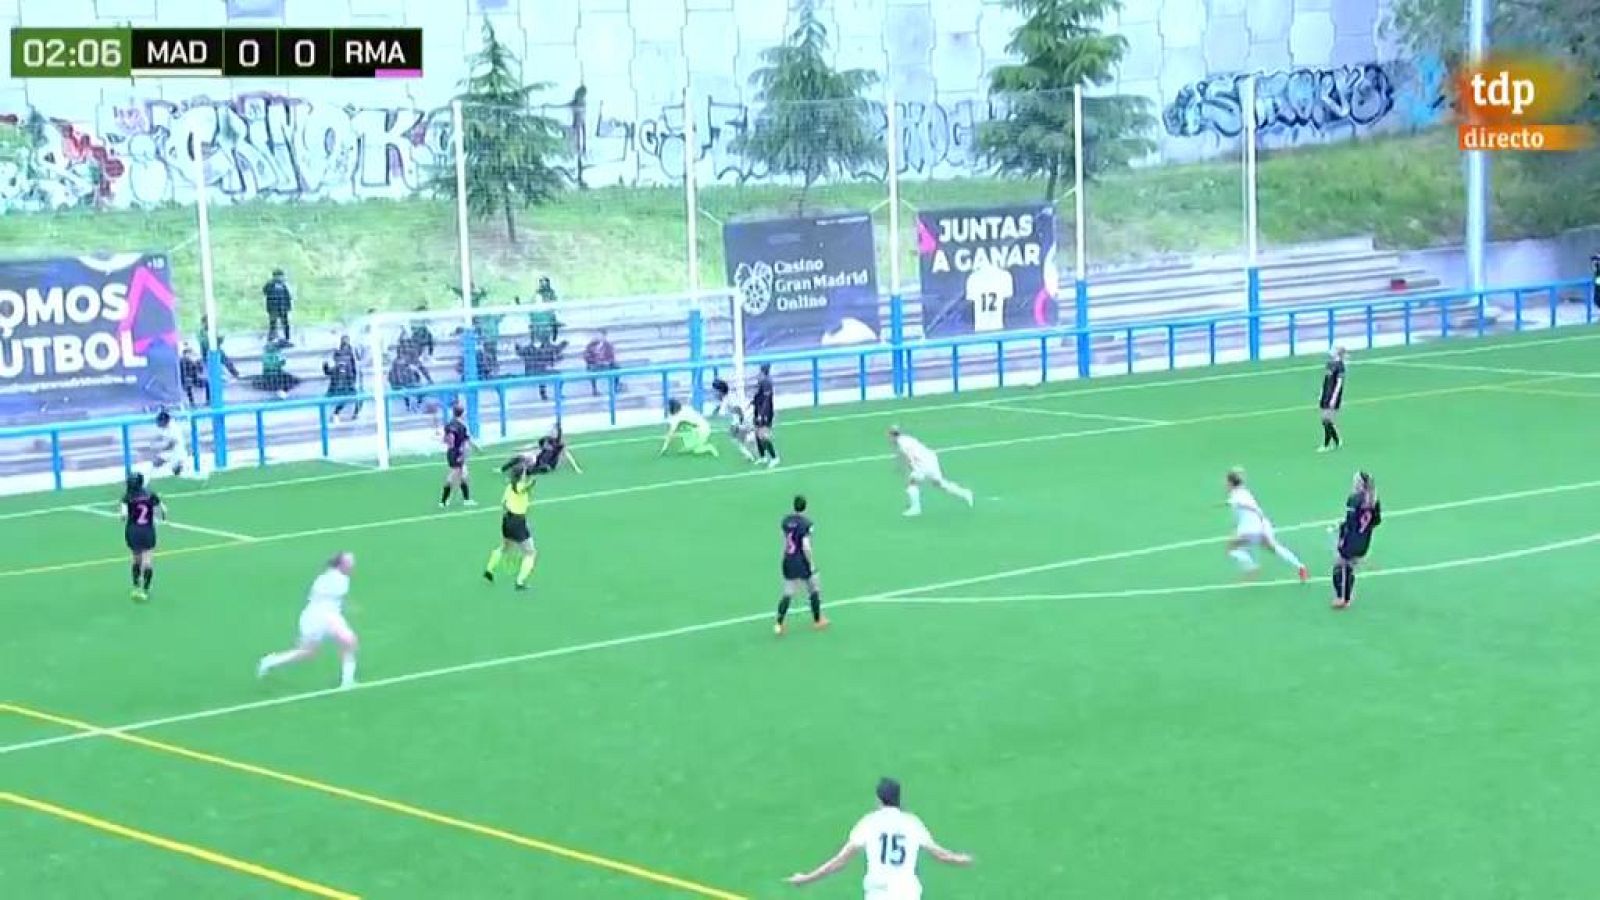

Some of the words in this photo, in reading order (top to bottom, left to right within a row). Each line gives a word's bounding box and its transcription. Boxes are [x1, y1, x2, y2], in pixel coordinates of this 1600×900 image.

[938, 213, 1034, 242] JUNTAS
[774, 256, 825, 274] Casino
[932, 248, 951, 273] A
[954, 242, 1042, 273] GANAR
[981, 292, 998, 312] 12
[135, 503, 149, 526] 2
[879, 831, 906, 867] 15
